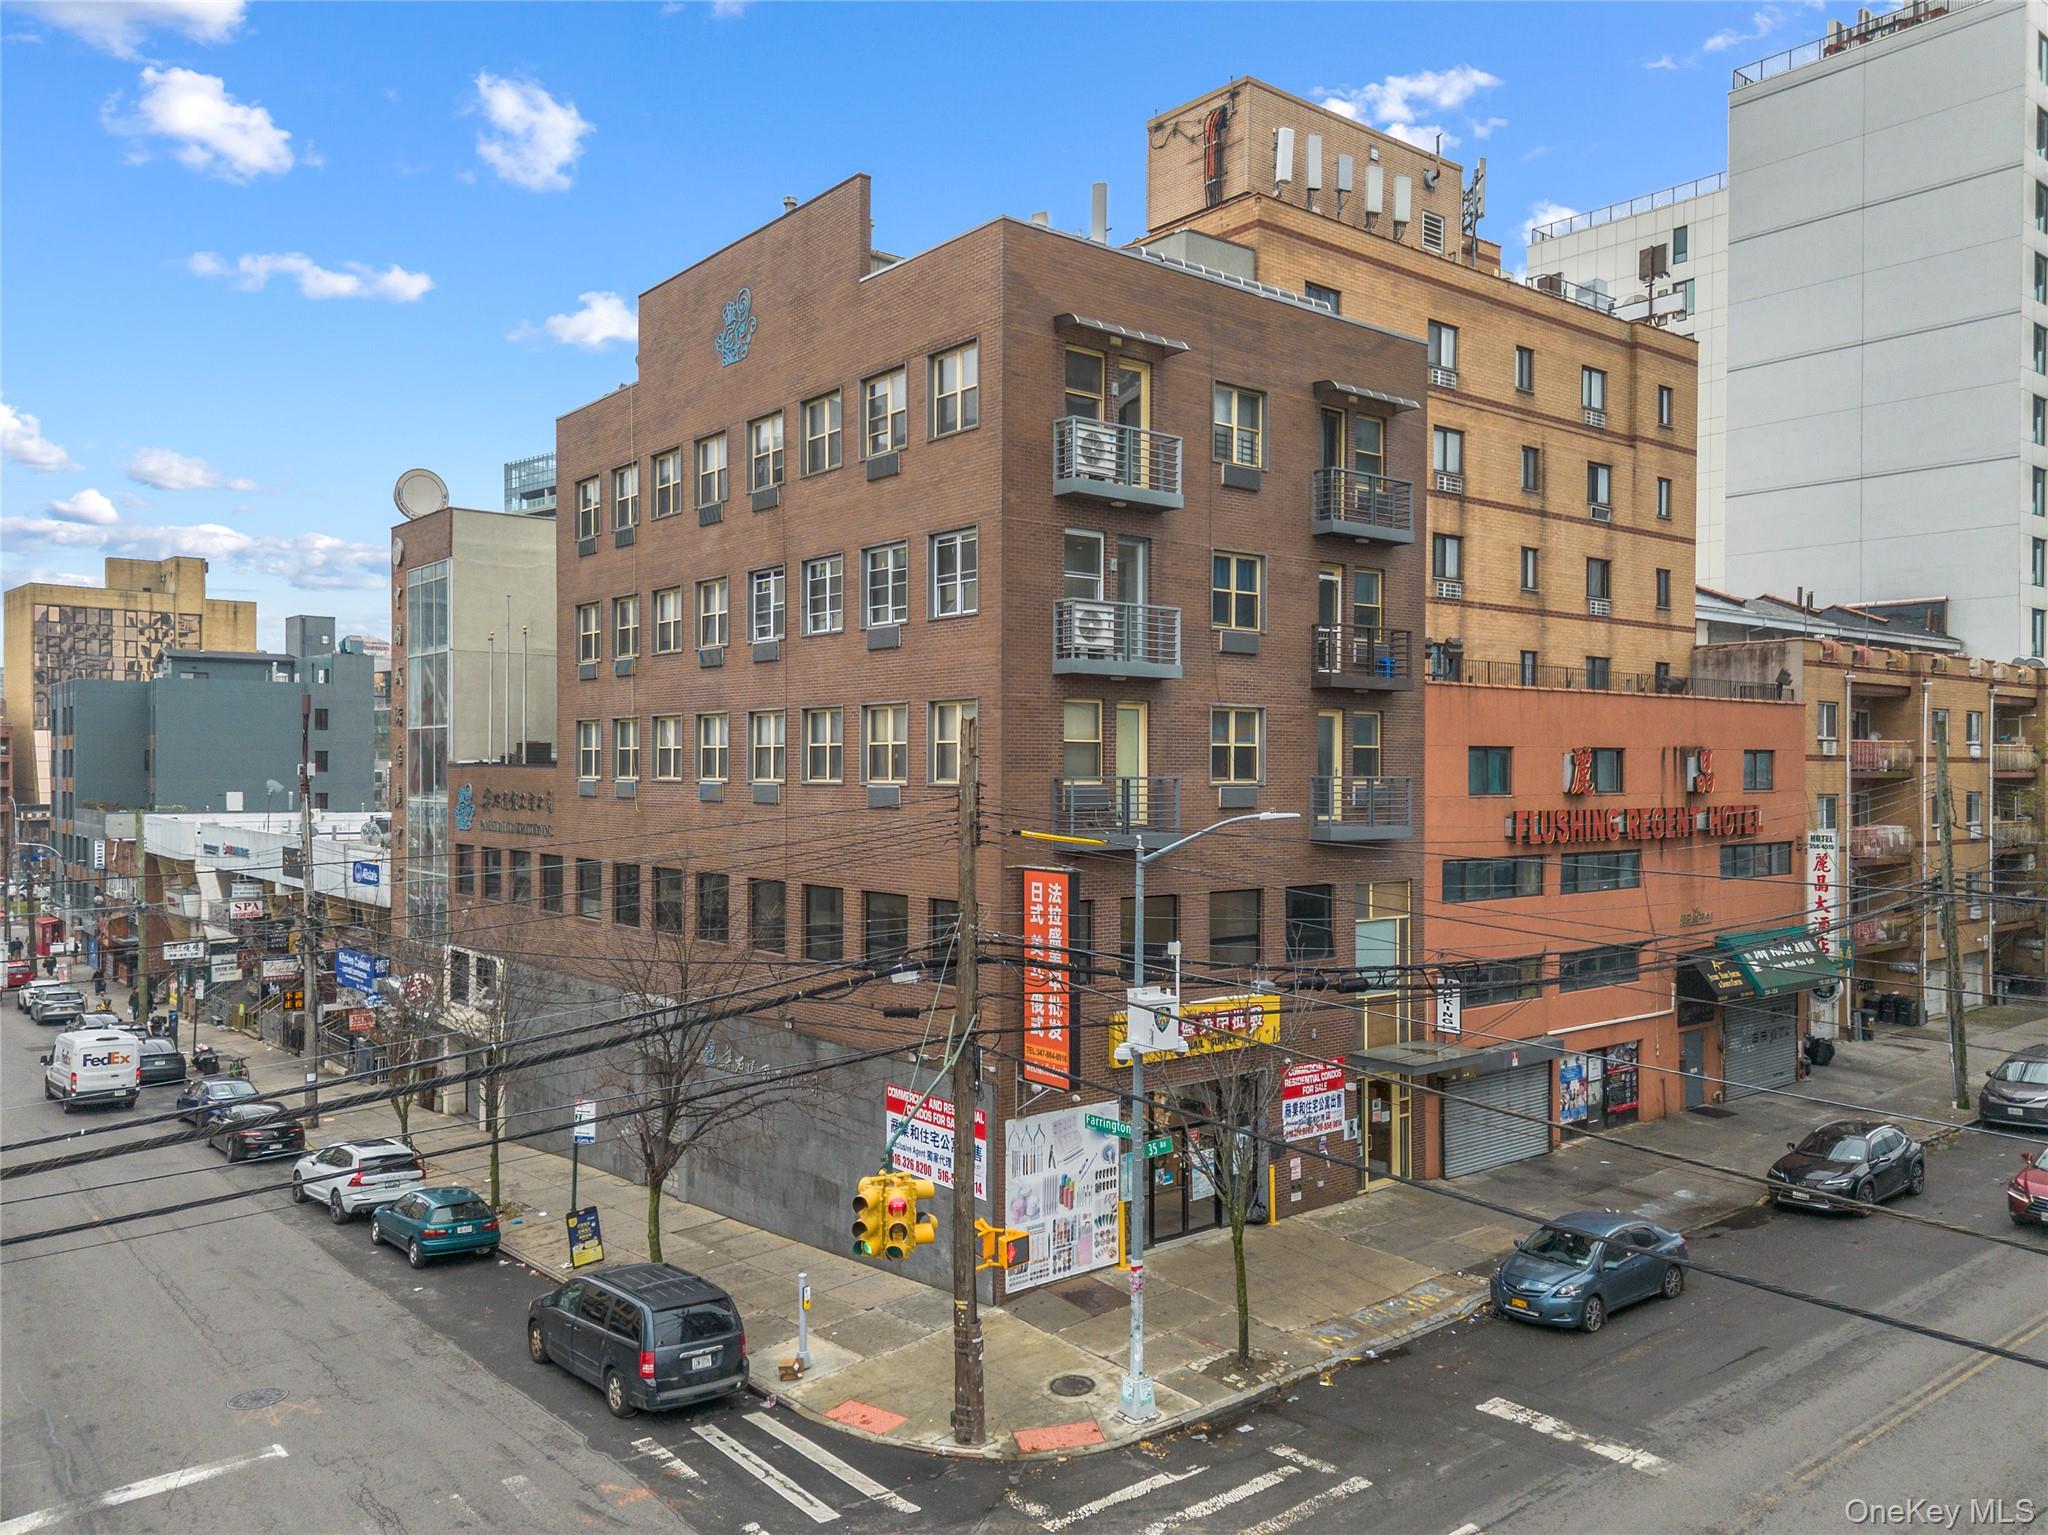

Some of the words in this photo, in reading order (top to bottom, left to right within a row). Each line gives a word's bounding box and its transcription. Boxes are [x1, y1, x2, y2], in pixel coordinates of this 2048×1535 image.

[1514, 808, 1619, 845] FLUSHING
[1626, 806, 1701, 840] REGENT
[1707, 805, 1764, 837] HOTEL
[1810, 835, 1833, 844] HOTEL
[235, 902, 259, 911] SPA
[1030, 881, 1044, 926] 日式
[1812, 852, 1832, 954] 麗晶大酒店
[83, 1051, 131, 1067] FedEx
[1284, 1073, 1321, 1087] RESIDENTIAL
[1321, 1068, 1342, 1081] CONDOS
[1302, 1084, 1315, 1095] FOR
[1315, 1081, 1328, 1092] SALE
[928, 1098, 943, 1112] AND
[932, 1112, 946, 1126] FOR
[1086, 1114, 1132, 1135] Farrington
[1148, 1143, 1158, 1155] 35
